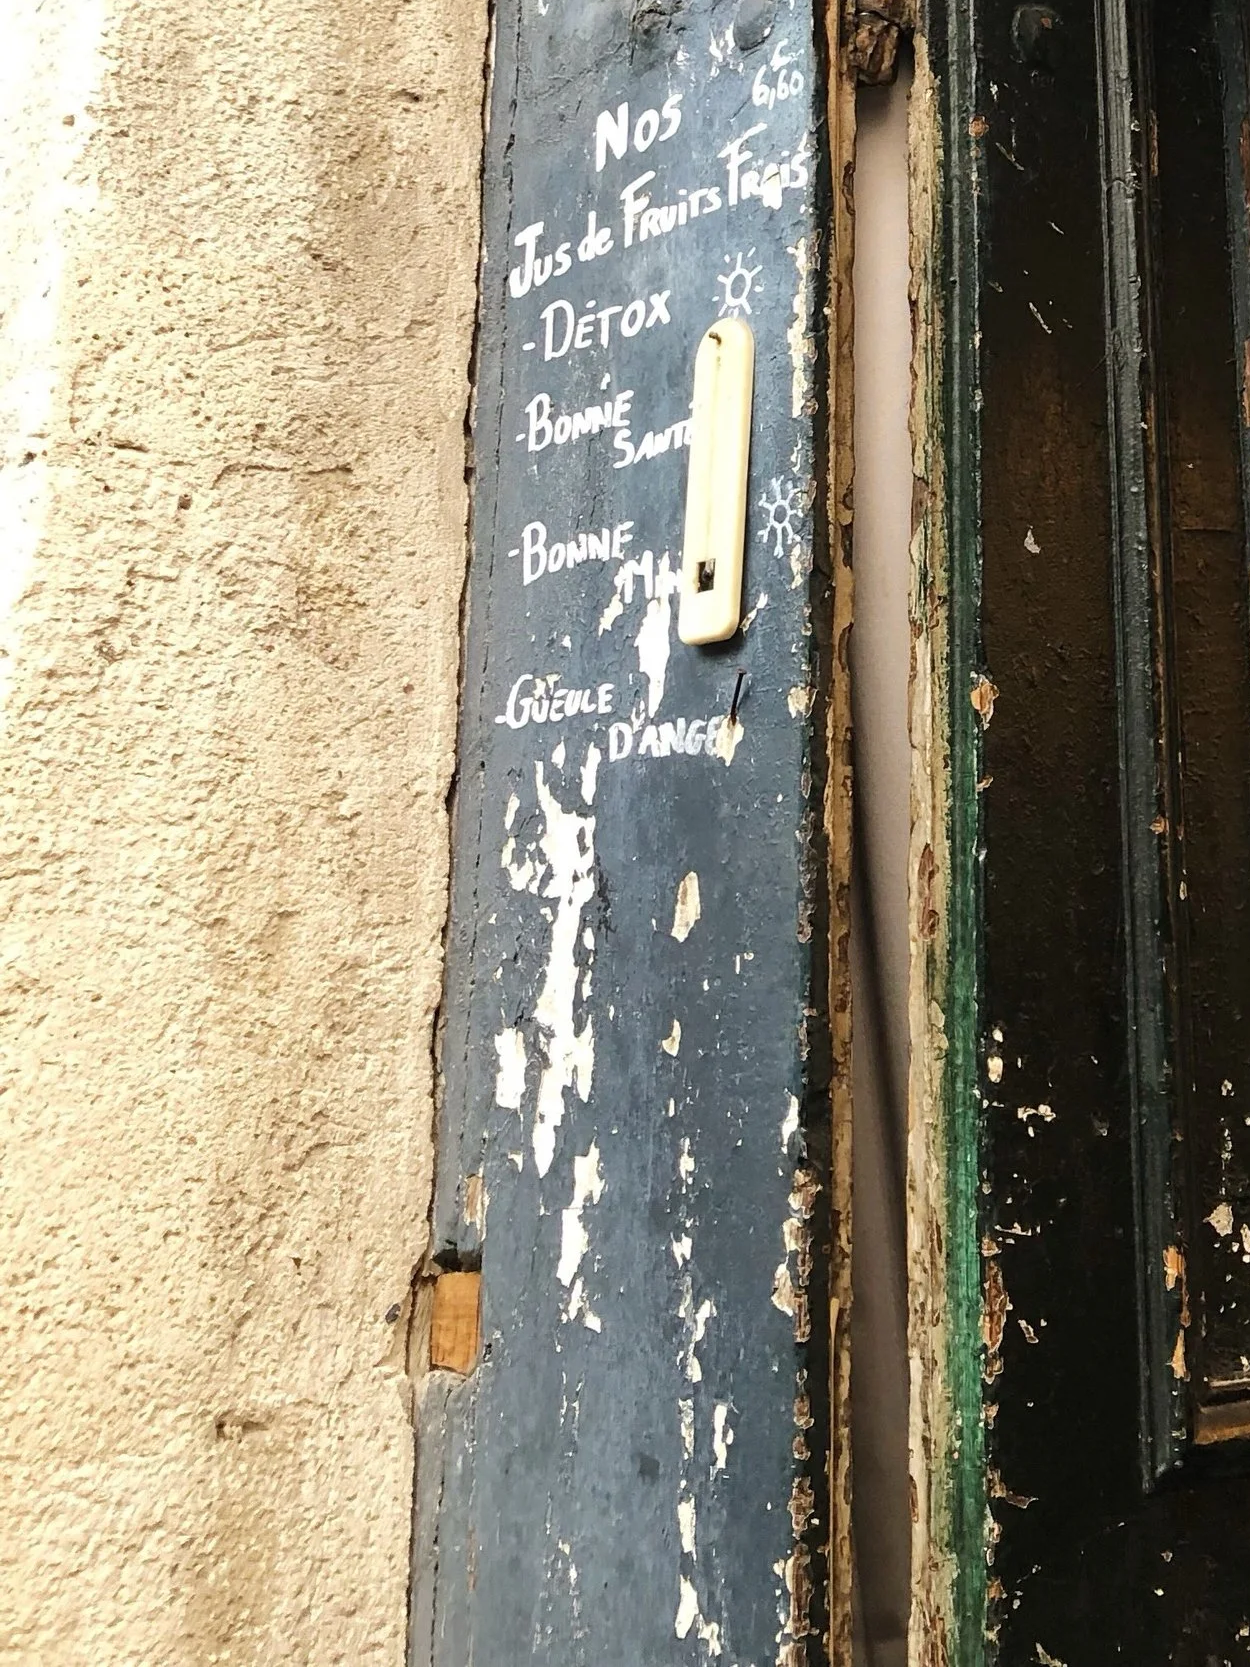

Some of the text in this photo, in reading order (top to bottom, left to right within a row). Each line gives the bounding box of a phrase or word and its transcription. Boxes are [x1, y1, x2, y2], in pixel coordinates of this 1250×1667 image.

[752, 63, 805, 111] 6,60
[595, 93, 683, 173] NOS
[509, 220, 572, 299] Jus
[577, 210, 614, 262] de
[613, 403, 694, 469] SANT
